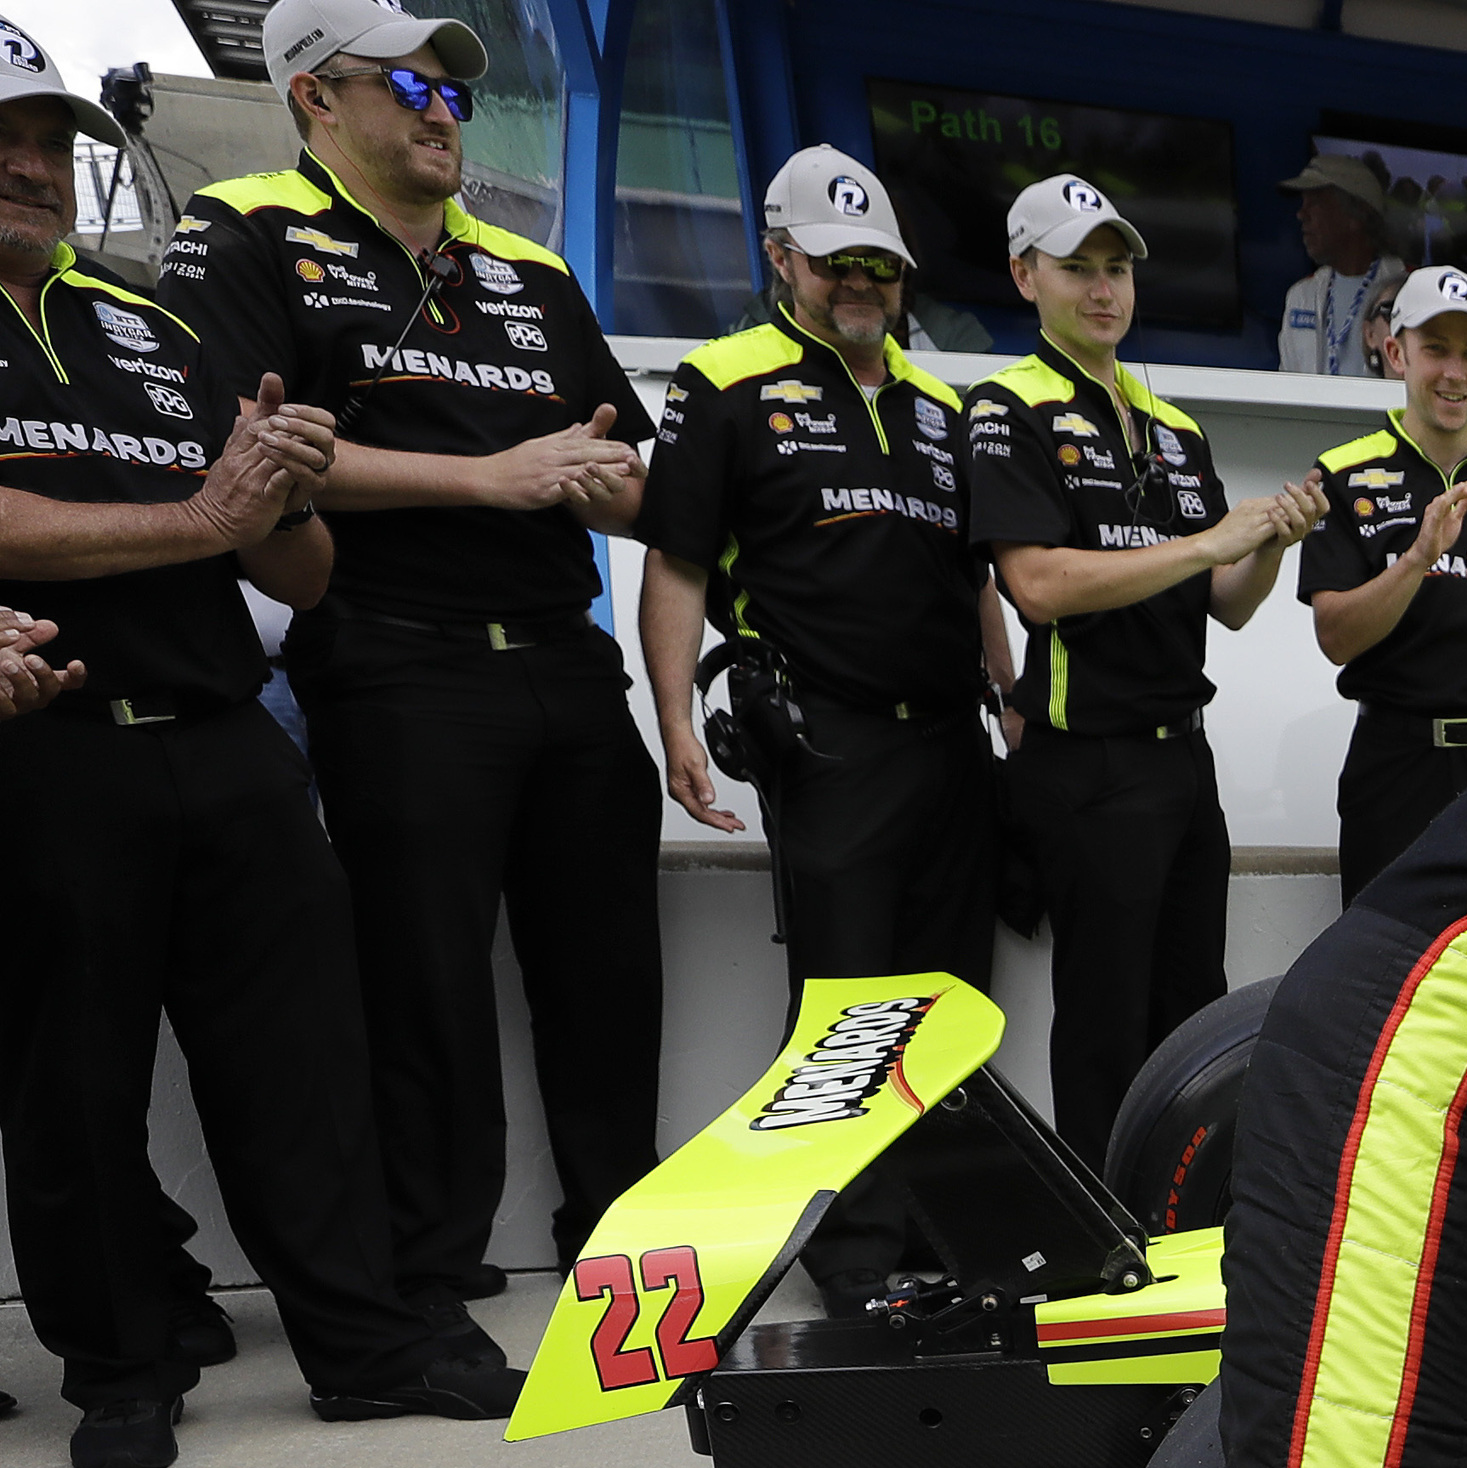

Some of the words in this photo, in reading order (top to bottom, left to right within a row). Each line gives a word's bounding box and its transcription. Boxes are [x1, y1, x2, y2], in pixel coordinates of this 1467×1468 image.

[910, 100, 1003, 144] Path
[1017, 114, 1062, 150] 16
[475, 300, 543, 320] verizon
[508, 324, 543, 347] PPG
[107, 353, 186, 384] verizon
[361, 343, 556, 394] MENARDS
[150, 387, 188, 414] PPG
[0, 417, 207, 469] MENARDS
[820, 487, 959, 529] MENARDS
[752, 996, 922, 1130] MENARDS
[573, 1245, 719, 1392] 22
